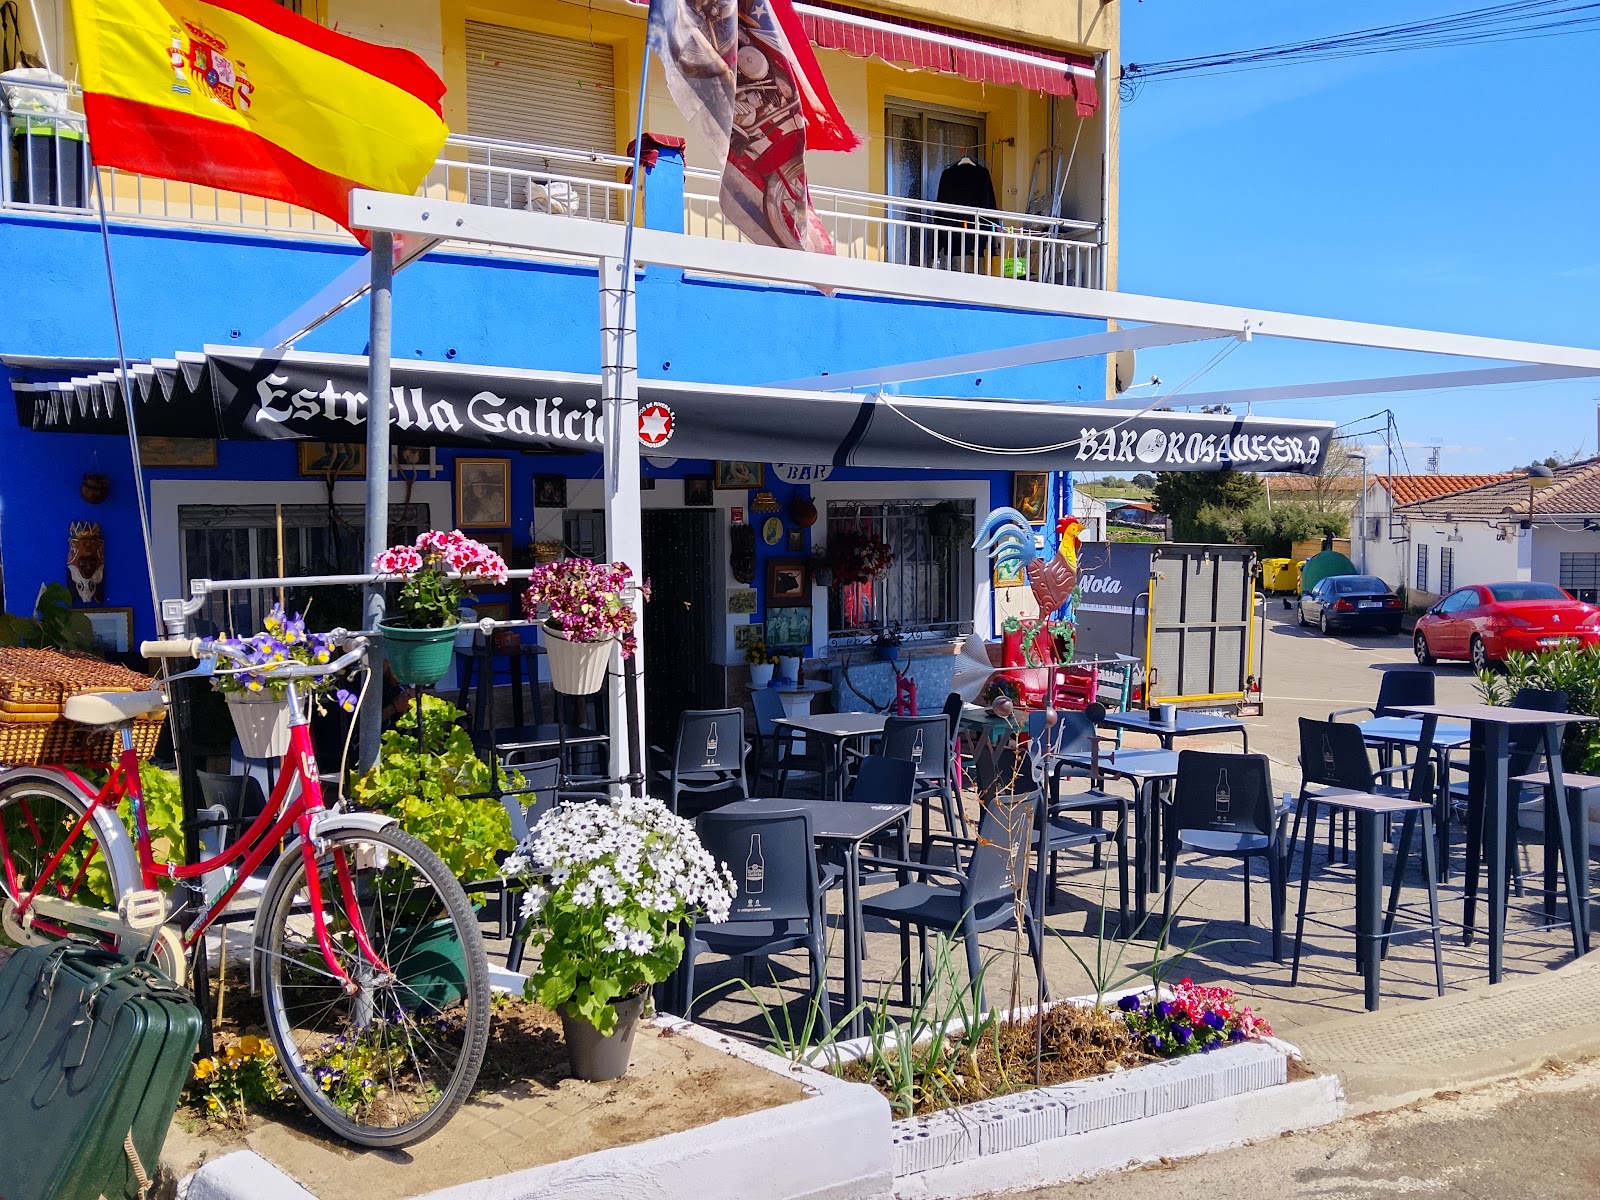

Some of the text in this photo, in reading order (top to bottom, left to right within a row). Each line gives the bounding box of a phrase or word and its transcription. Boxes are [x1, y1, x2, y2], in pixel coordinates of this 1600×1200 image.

[255, 373, 604, 444] Estrlla Galici
[1074, 427, 1137, 463] BAR
[786, 464, 826, 480] BAR
[1079, 574, 1122, 594] Nota
